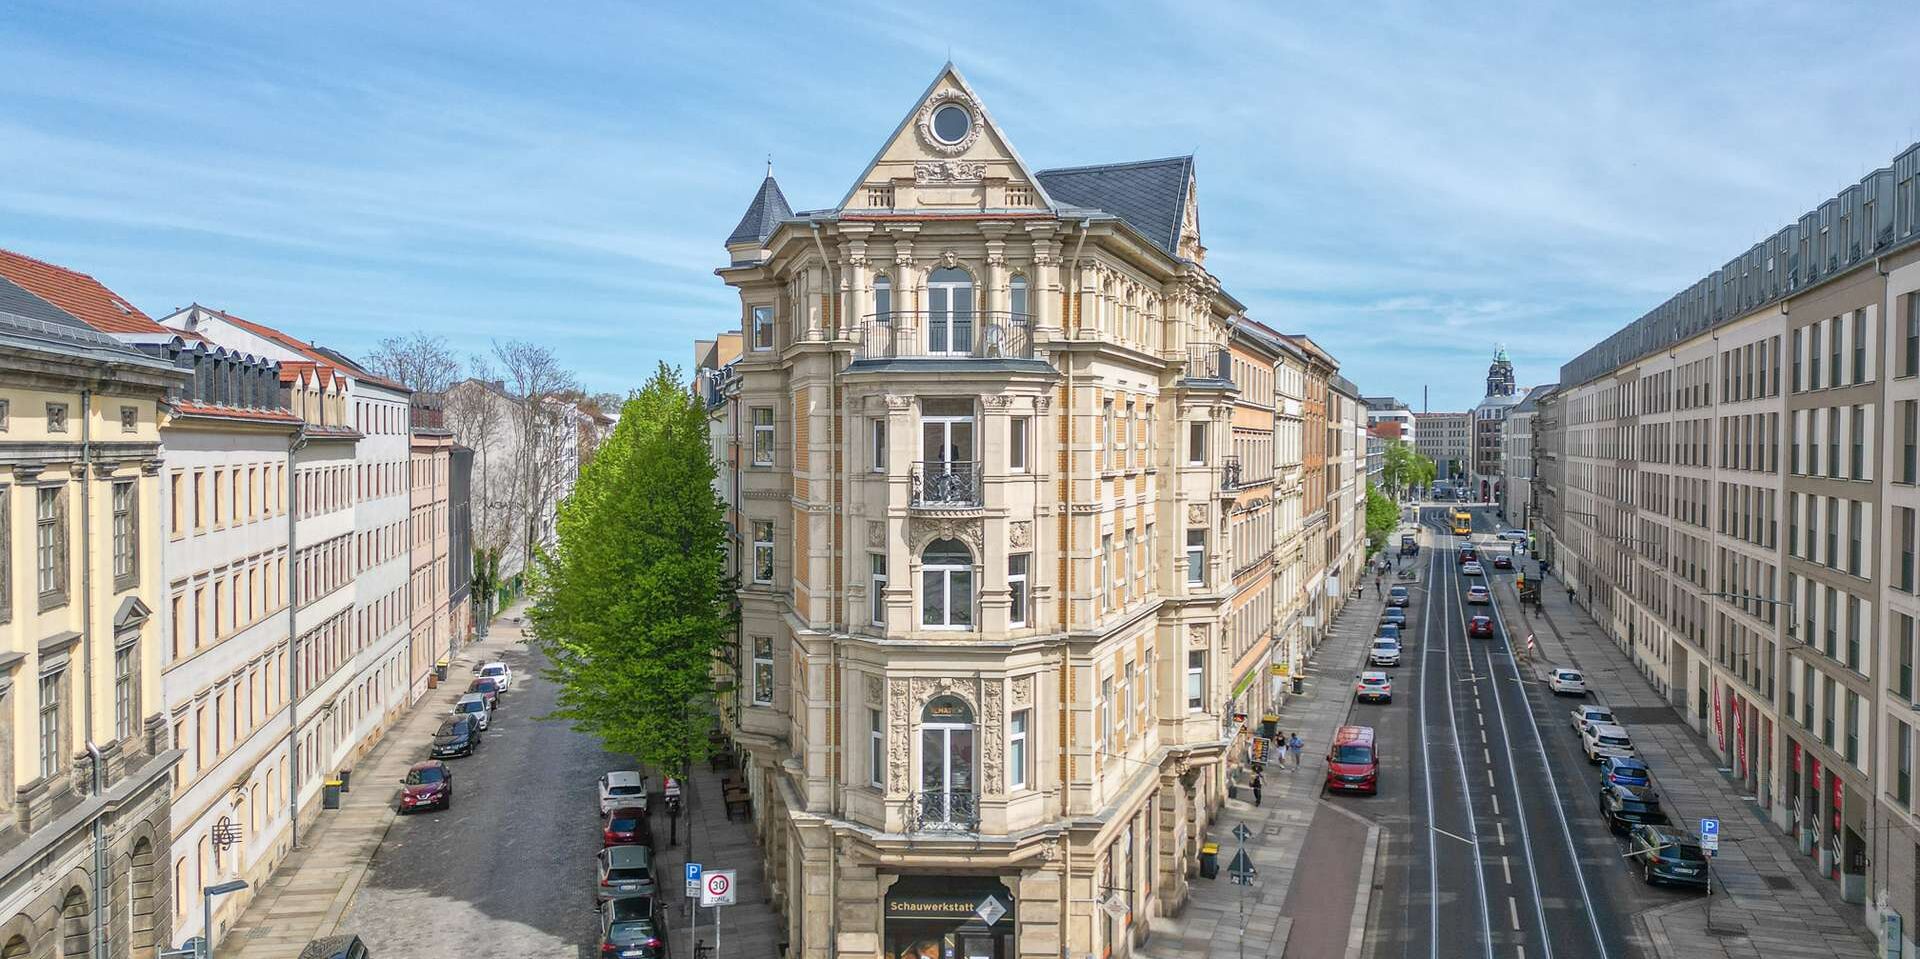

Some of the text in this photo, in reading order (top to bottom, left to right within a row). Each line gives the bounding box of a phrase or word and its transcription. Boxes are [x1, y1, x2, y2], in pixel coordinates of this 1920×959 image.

[1706, 821, 1715, 832] P
[689, 865, 698, 878] P
[712, 880, 725, 891] 30
[890, 901, 975, 912] Schauwerkstatt
